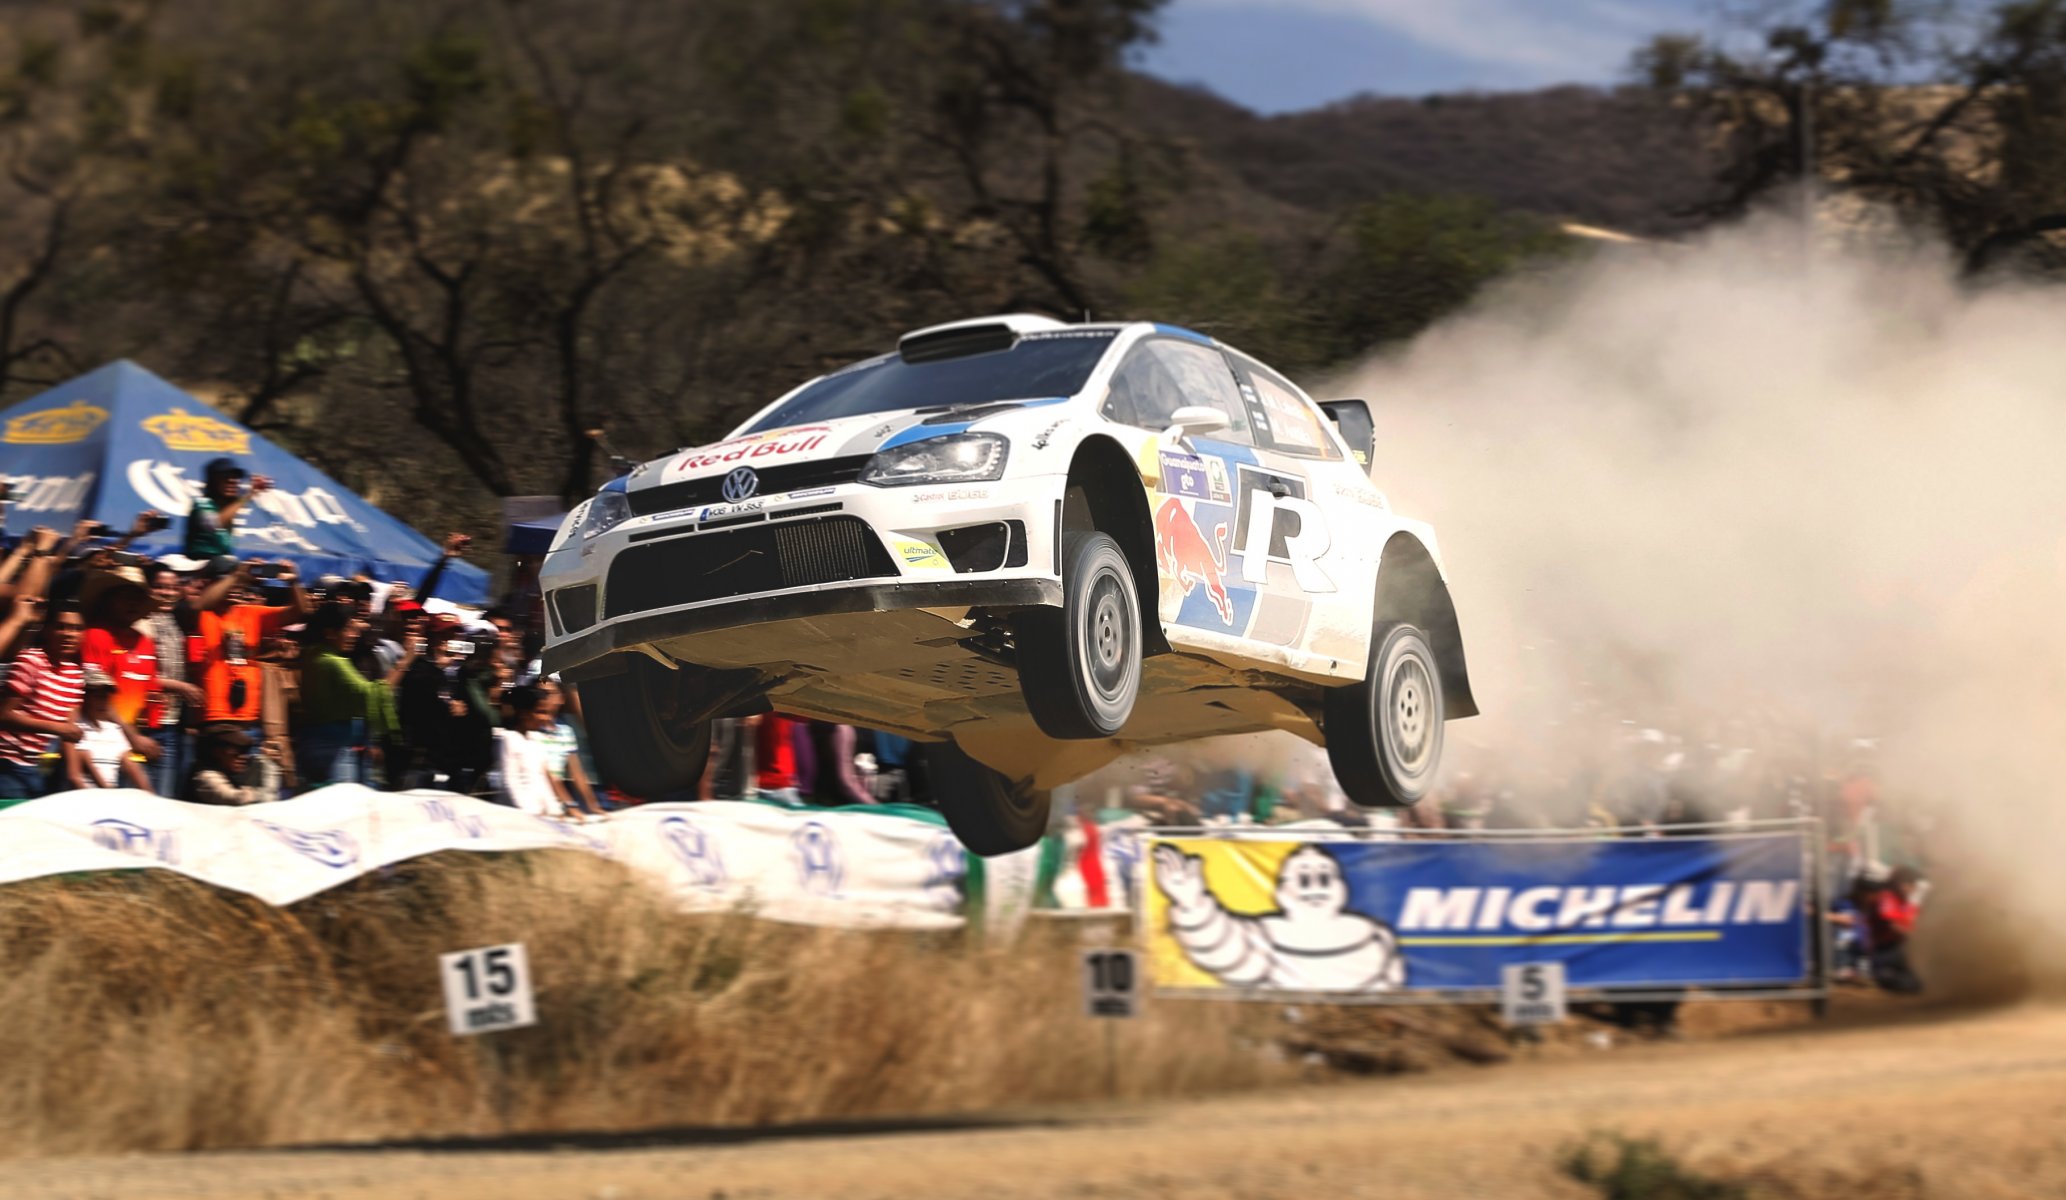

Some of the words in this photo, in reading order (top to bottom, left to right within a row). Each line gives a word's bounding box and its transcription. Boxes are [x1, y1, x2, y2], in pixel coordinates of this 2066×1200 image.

[678, 446, 751, 472] Red
[750, 434, 827, 458] Bull
[1398, 880, 1799, 931] MICHELIN
[453, 949, 517, 999] 15
[1087, 953, 1134, 992] 10
[1521, 965, 1547, 1000] 5
